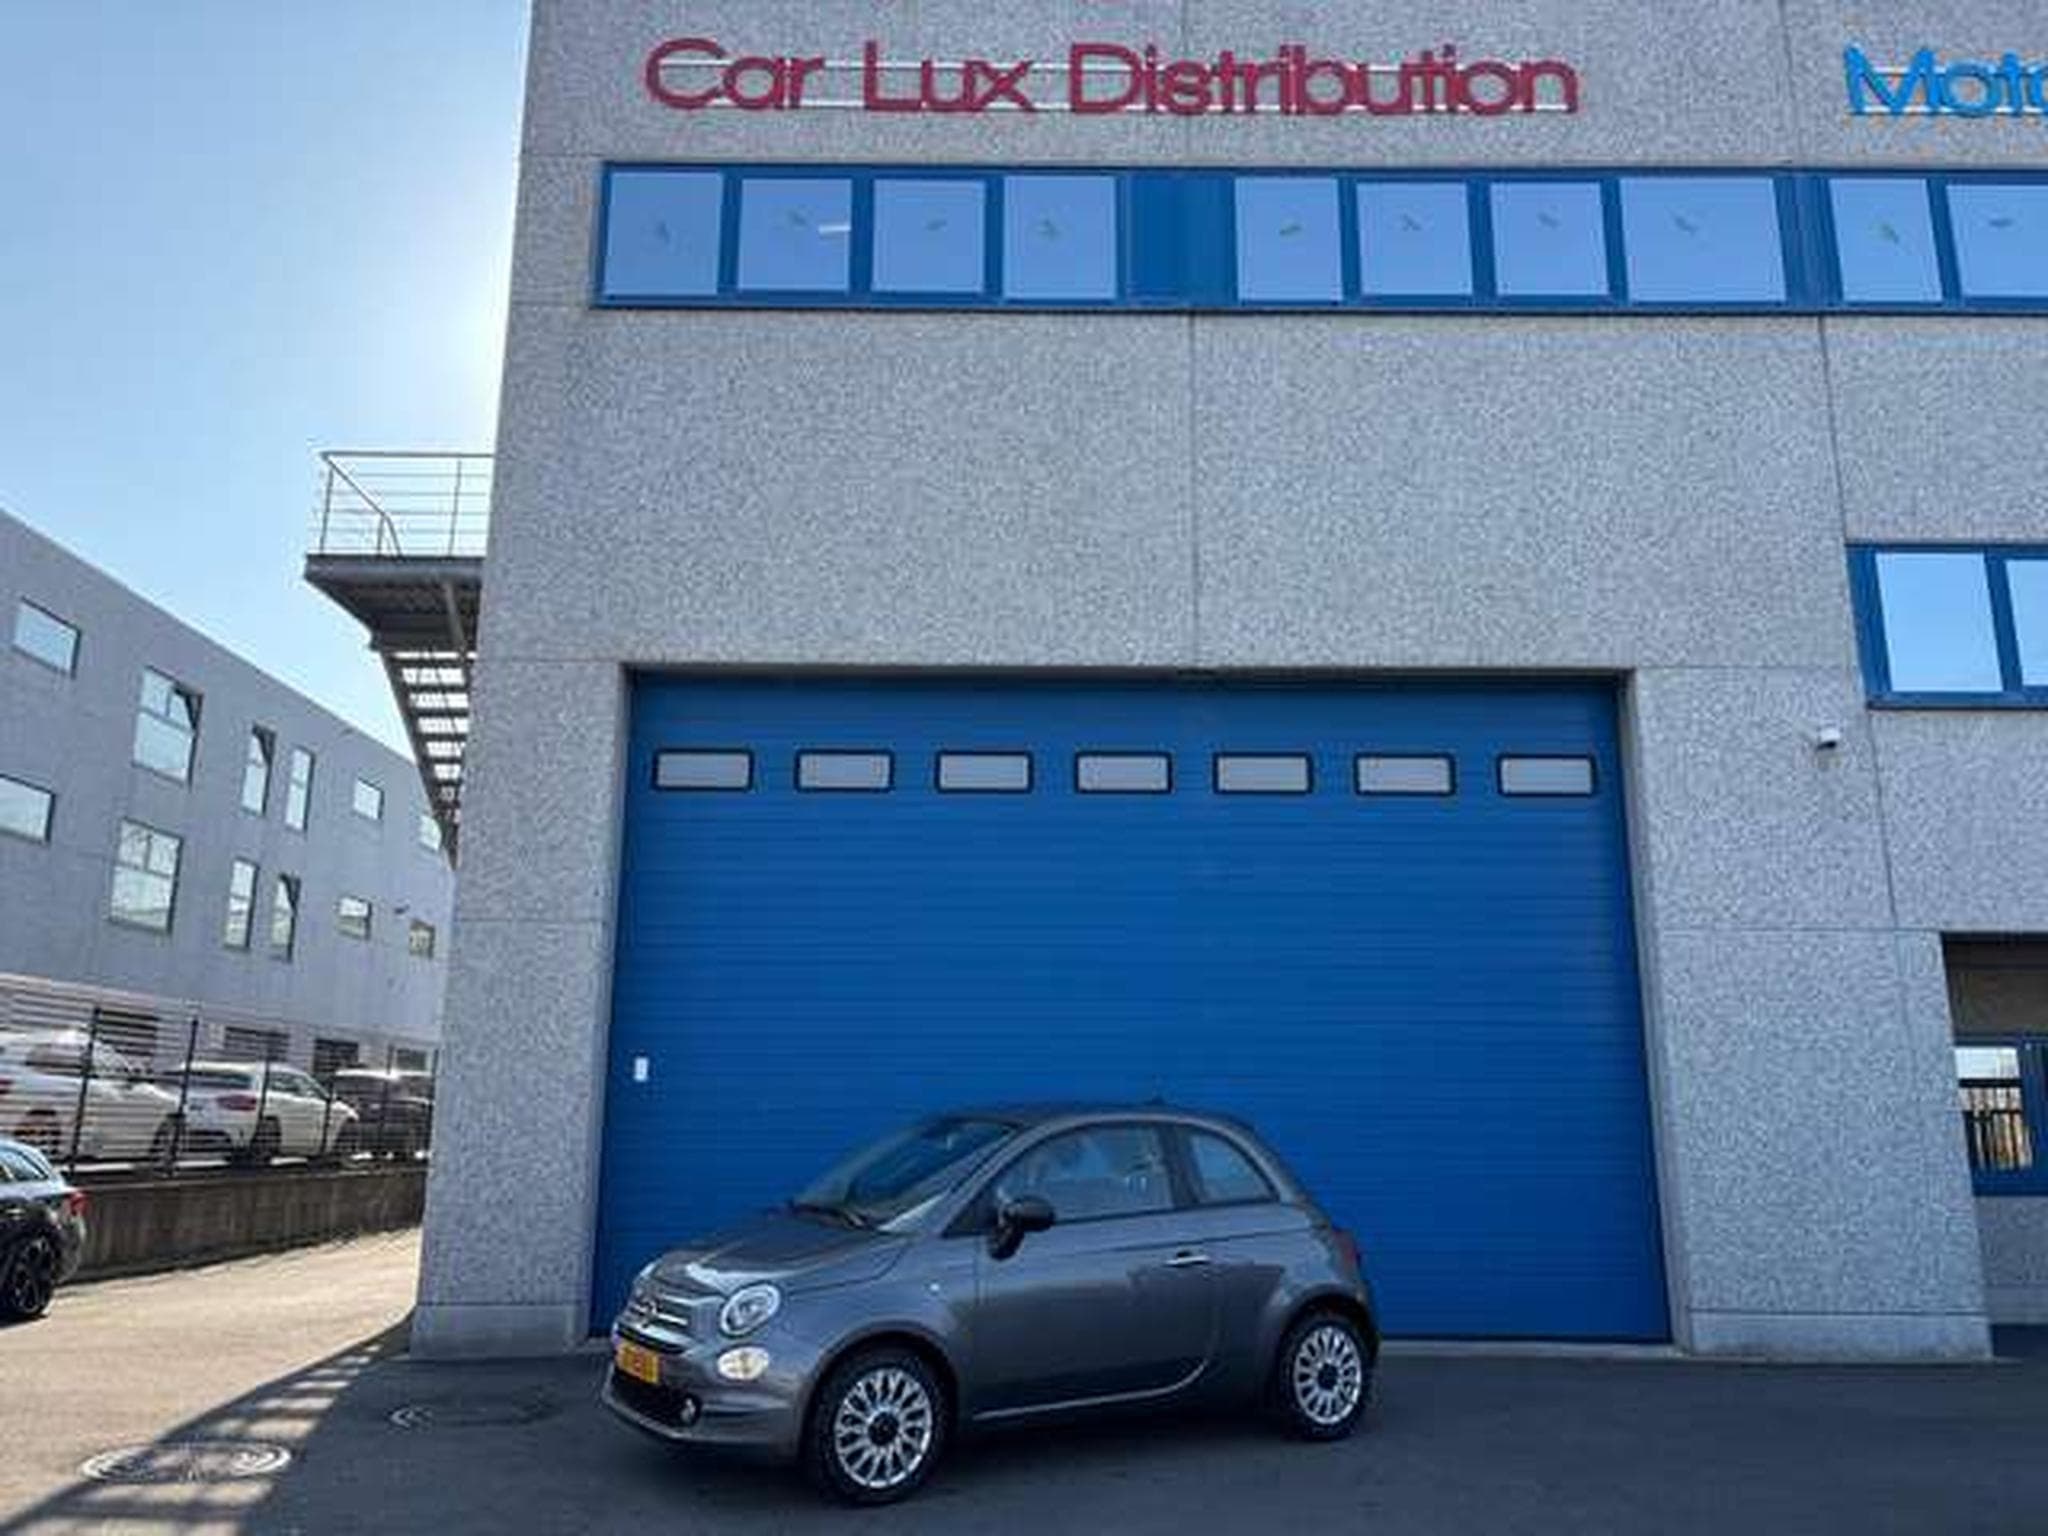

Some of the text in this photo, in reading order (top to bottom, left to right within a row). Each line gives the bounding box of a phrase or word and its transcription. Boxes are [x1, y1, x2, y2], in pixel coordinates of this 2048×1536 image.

[645, 37, 1580, 116] Car Lux Distribution
